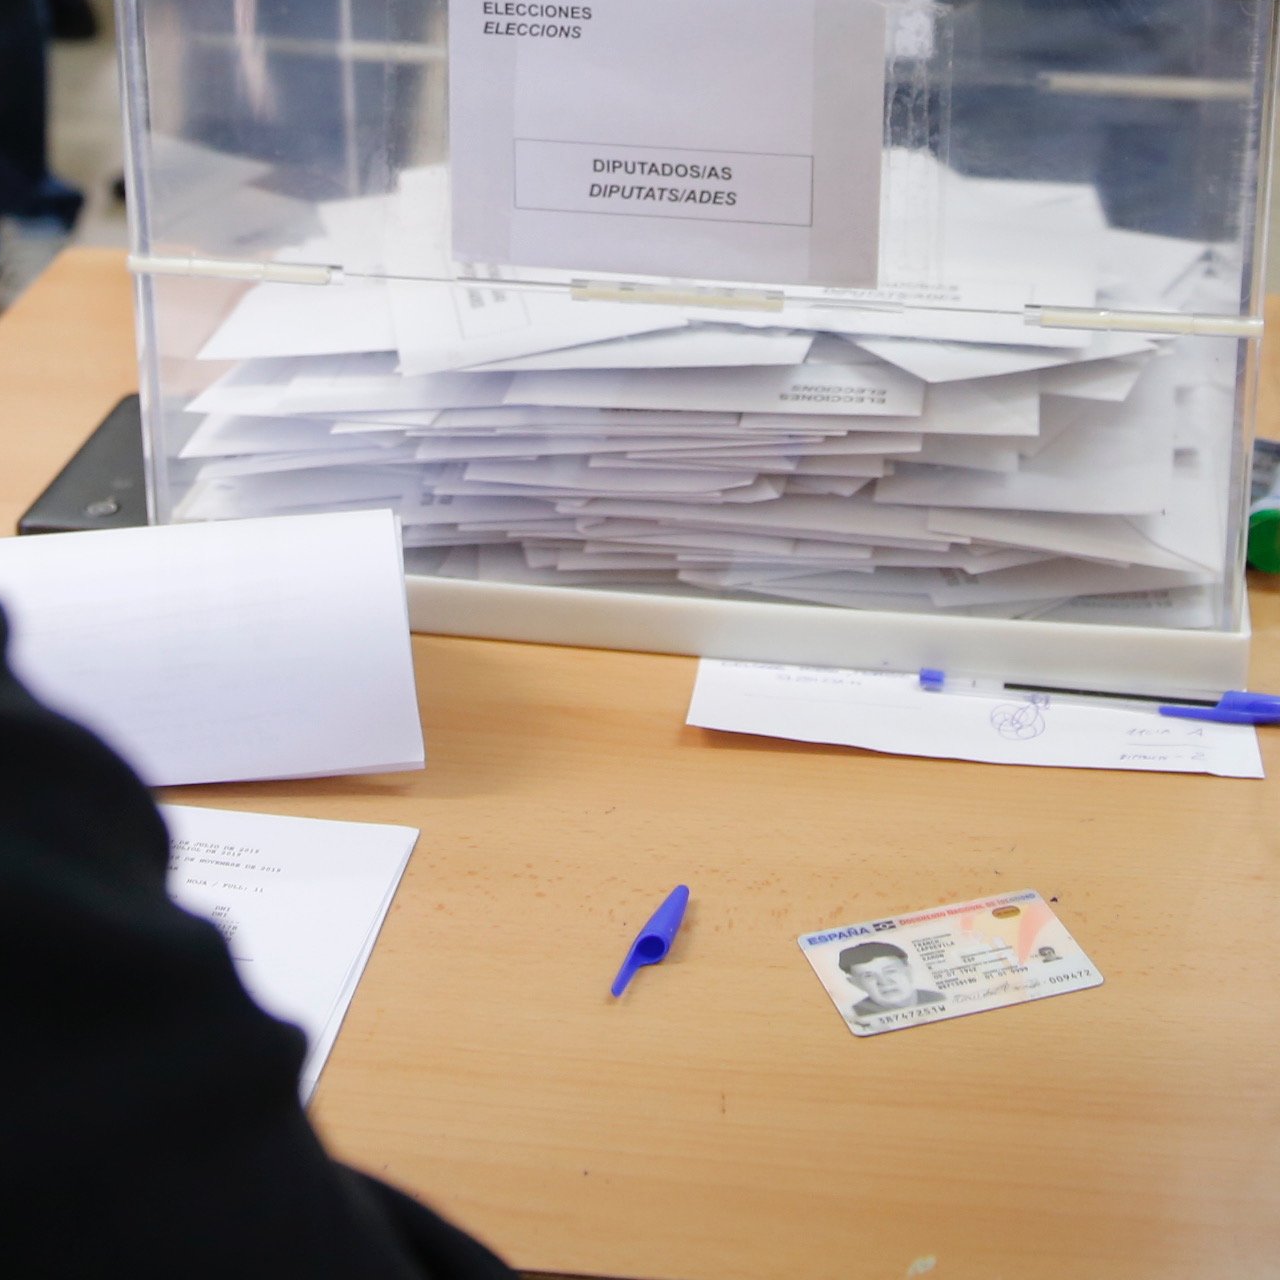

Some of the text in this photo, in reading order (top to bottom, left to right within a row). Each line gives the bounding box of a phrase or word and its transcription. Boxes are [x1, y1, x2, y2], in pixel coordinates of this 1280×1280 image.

[482, 0, 593, 21] ELECCIONES
[483, 20, 582, 39] ELECCIONS
[592, 158, 733, 181] DIPUTADOS/AS
[588, 183, 737, 206] DIPUTATS/ADES
[779, 393, 886, 405] ELECCIONES
[807, 927, 871, 946] ESPAÑA
